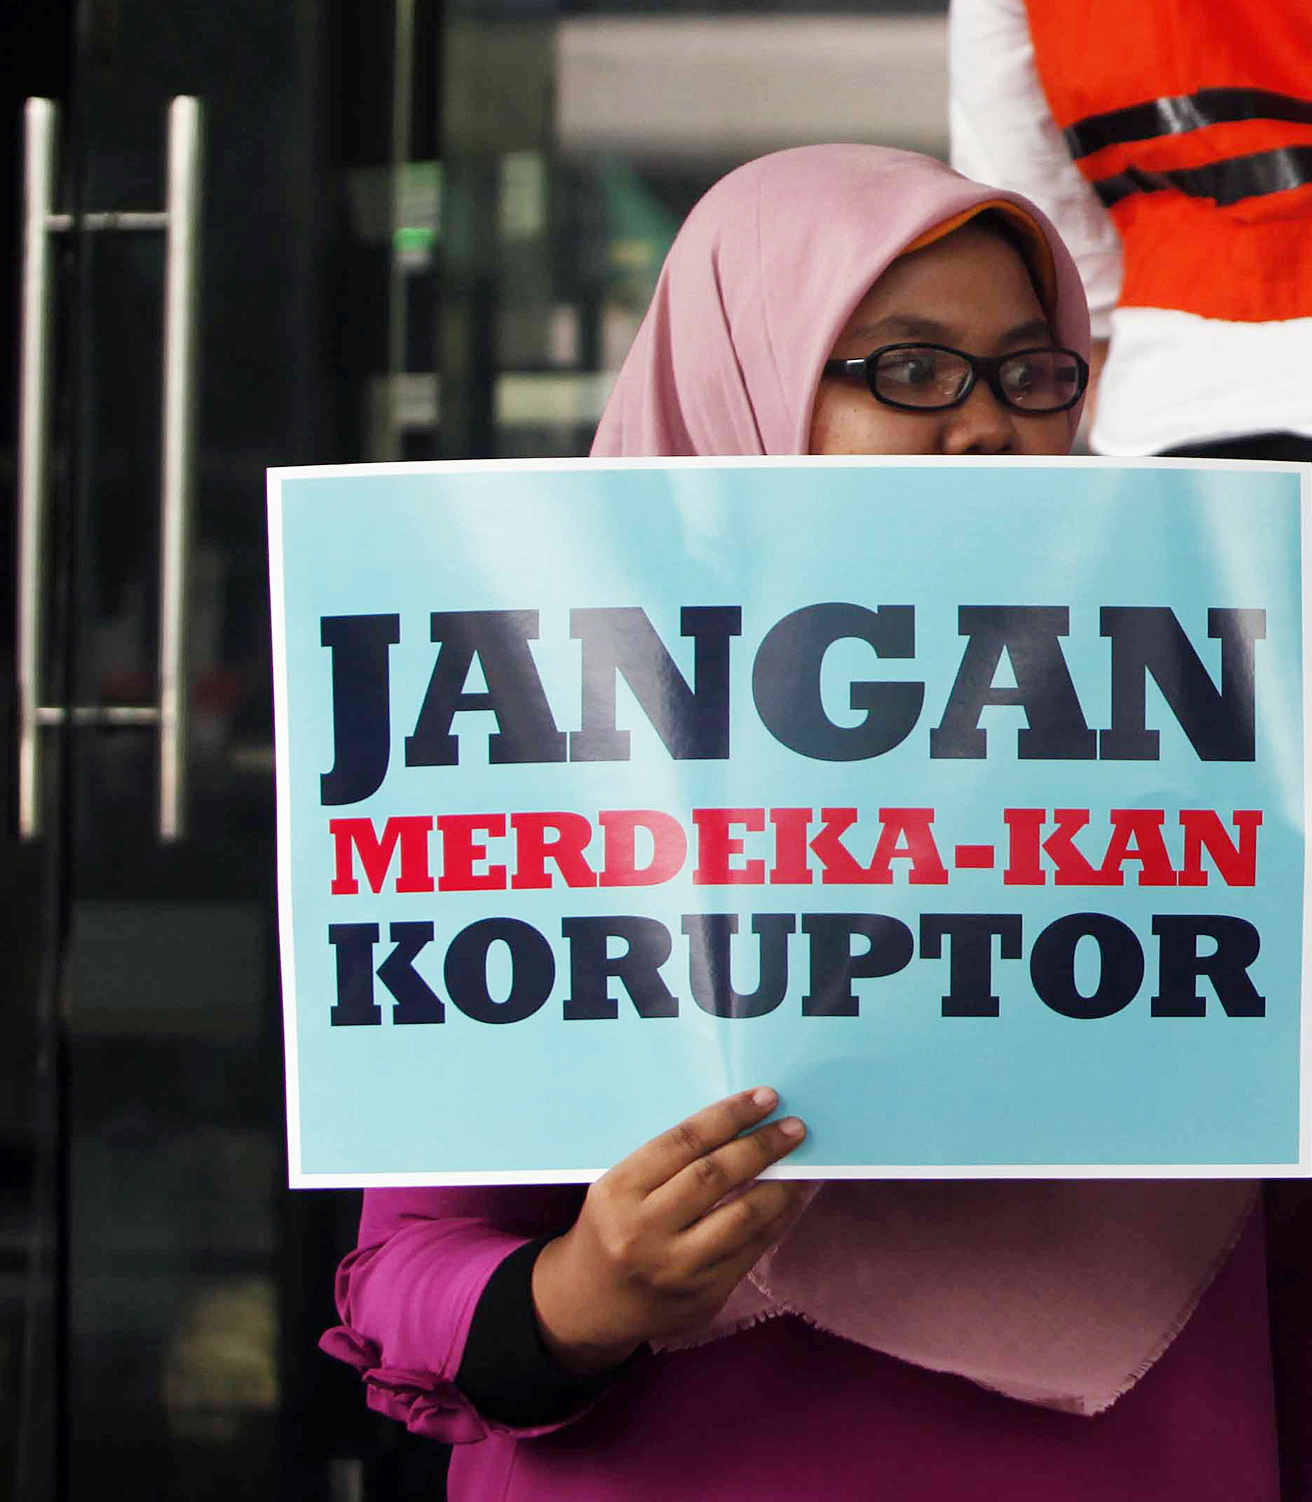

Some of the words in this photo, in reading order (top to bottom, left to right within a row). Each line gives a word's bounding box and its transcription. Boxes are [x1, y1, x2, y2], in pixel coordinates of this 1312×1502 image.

[320, 602, 1266, 806] JANGAN
[329, 807, 1262, 895] MERDEKA-KAN
[328, 912, 1266, 1027] KORUPTOR
